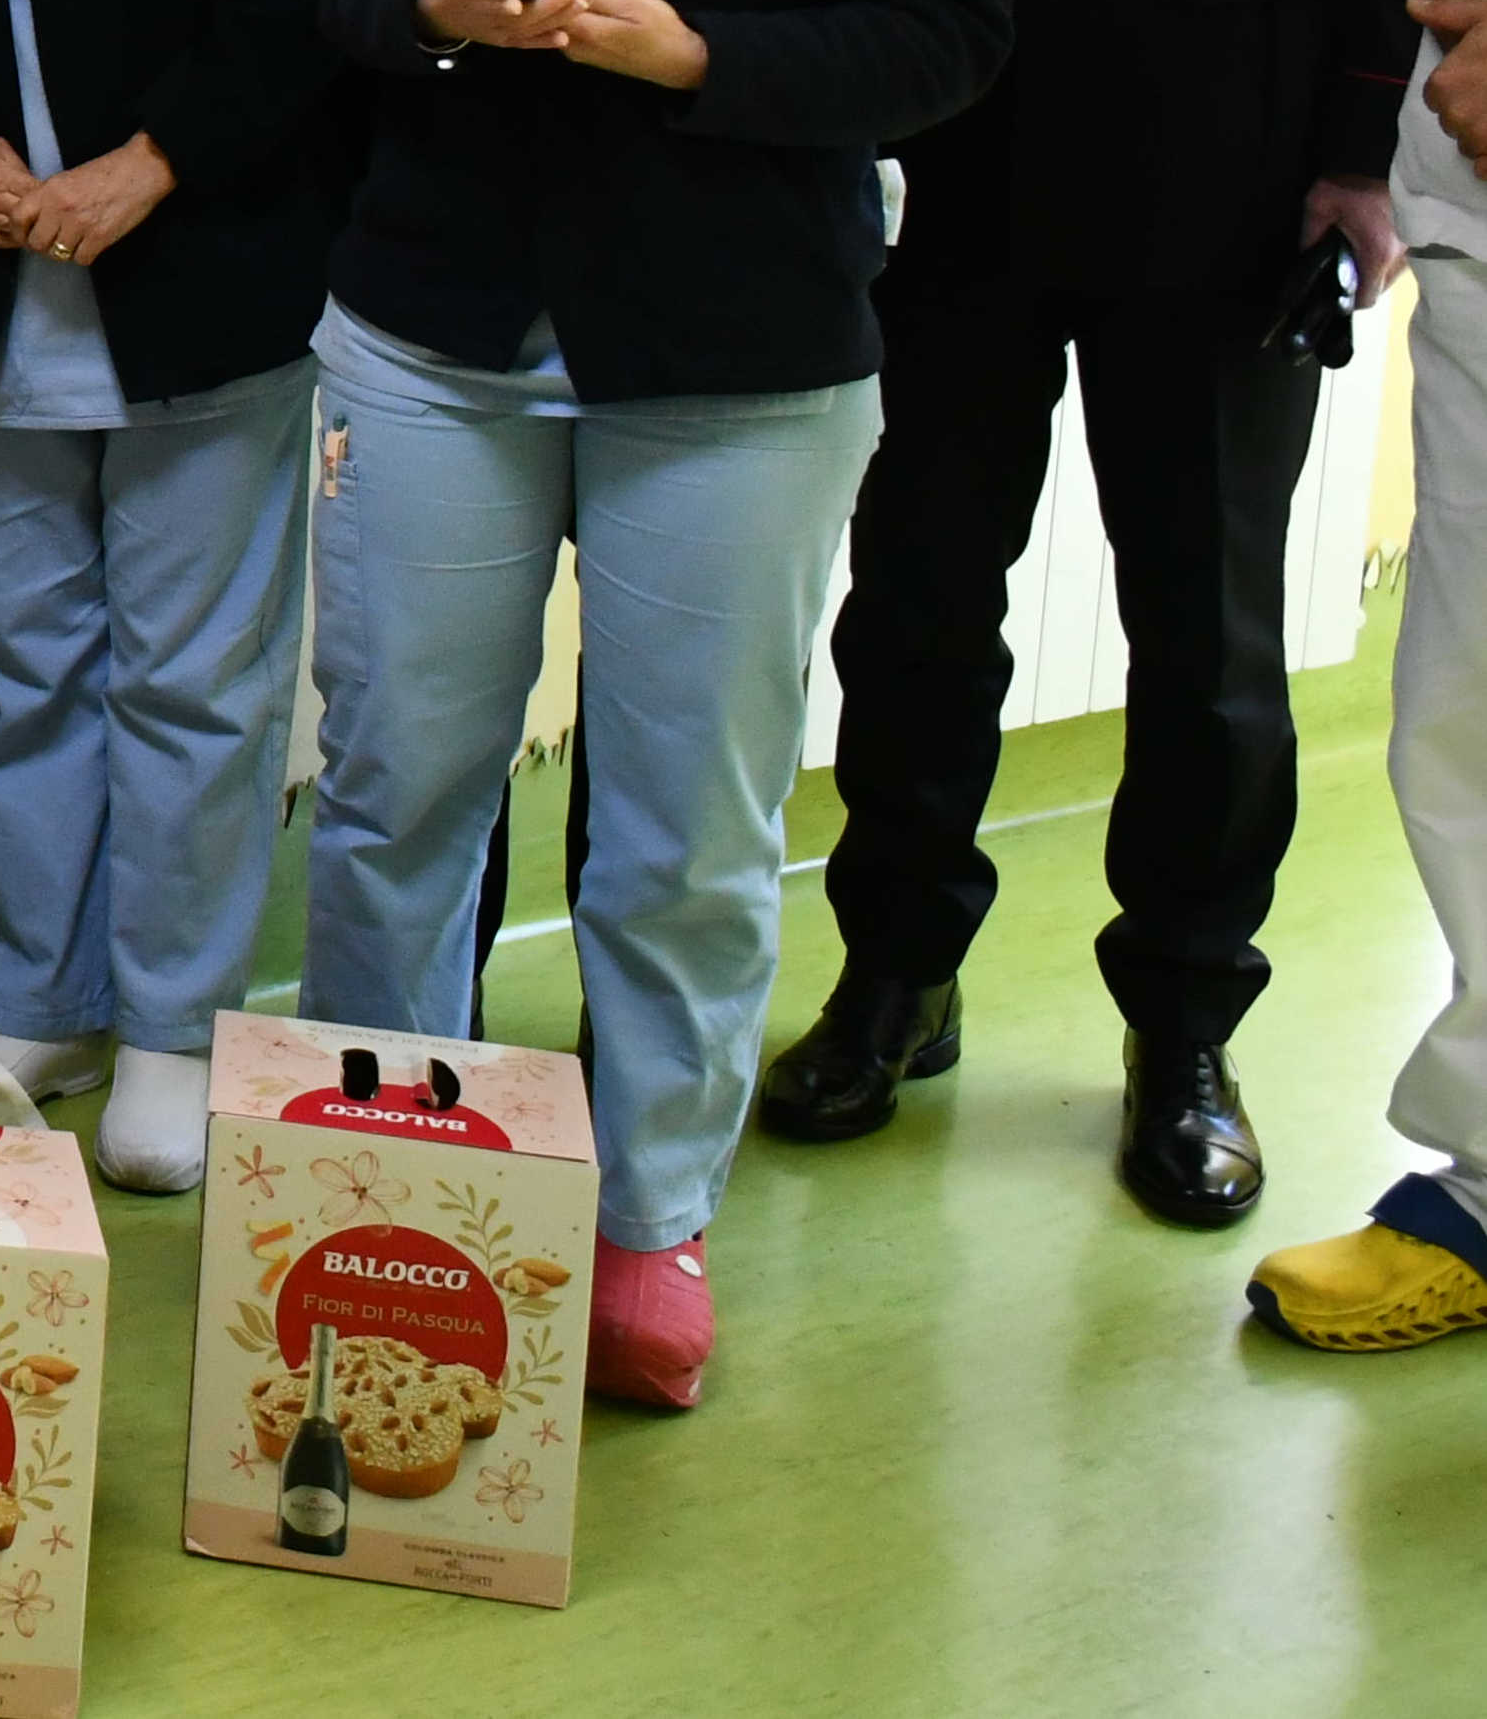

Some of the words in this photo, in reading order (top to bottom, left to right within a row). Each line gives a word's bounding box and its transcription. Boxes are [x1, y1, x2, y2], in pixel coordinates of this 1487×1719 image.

[322, 1103, 469, 1133] BALOCCO
[323, 1250, 471, 1291] BALOCCO
[302, 1293, 354, 1316] FIOR
[362, 1304, 384, 1321] DI
[392, 1306, 486, 1335] PASQUA
